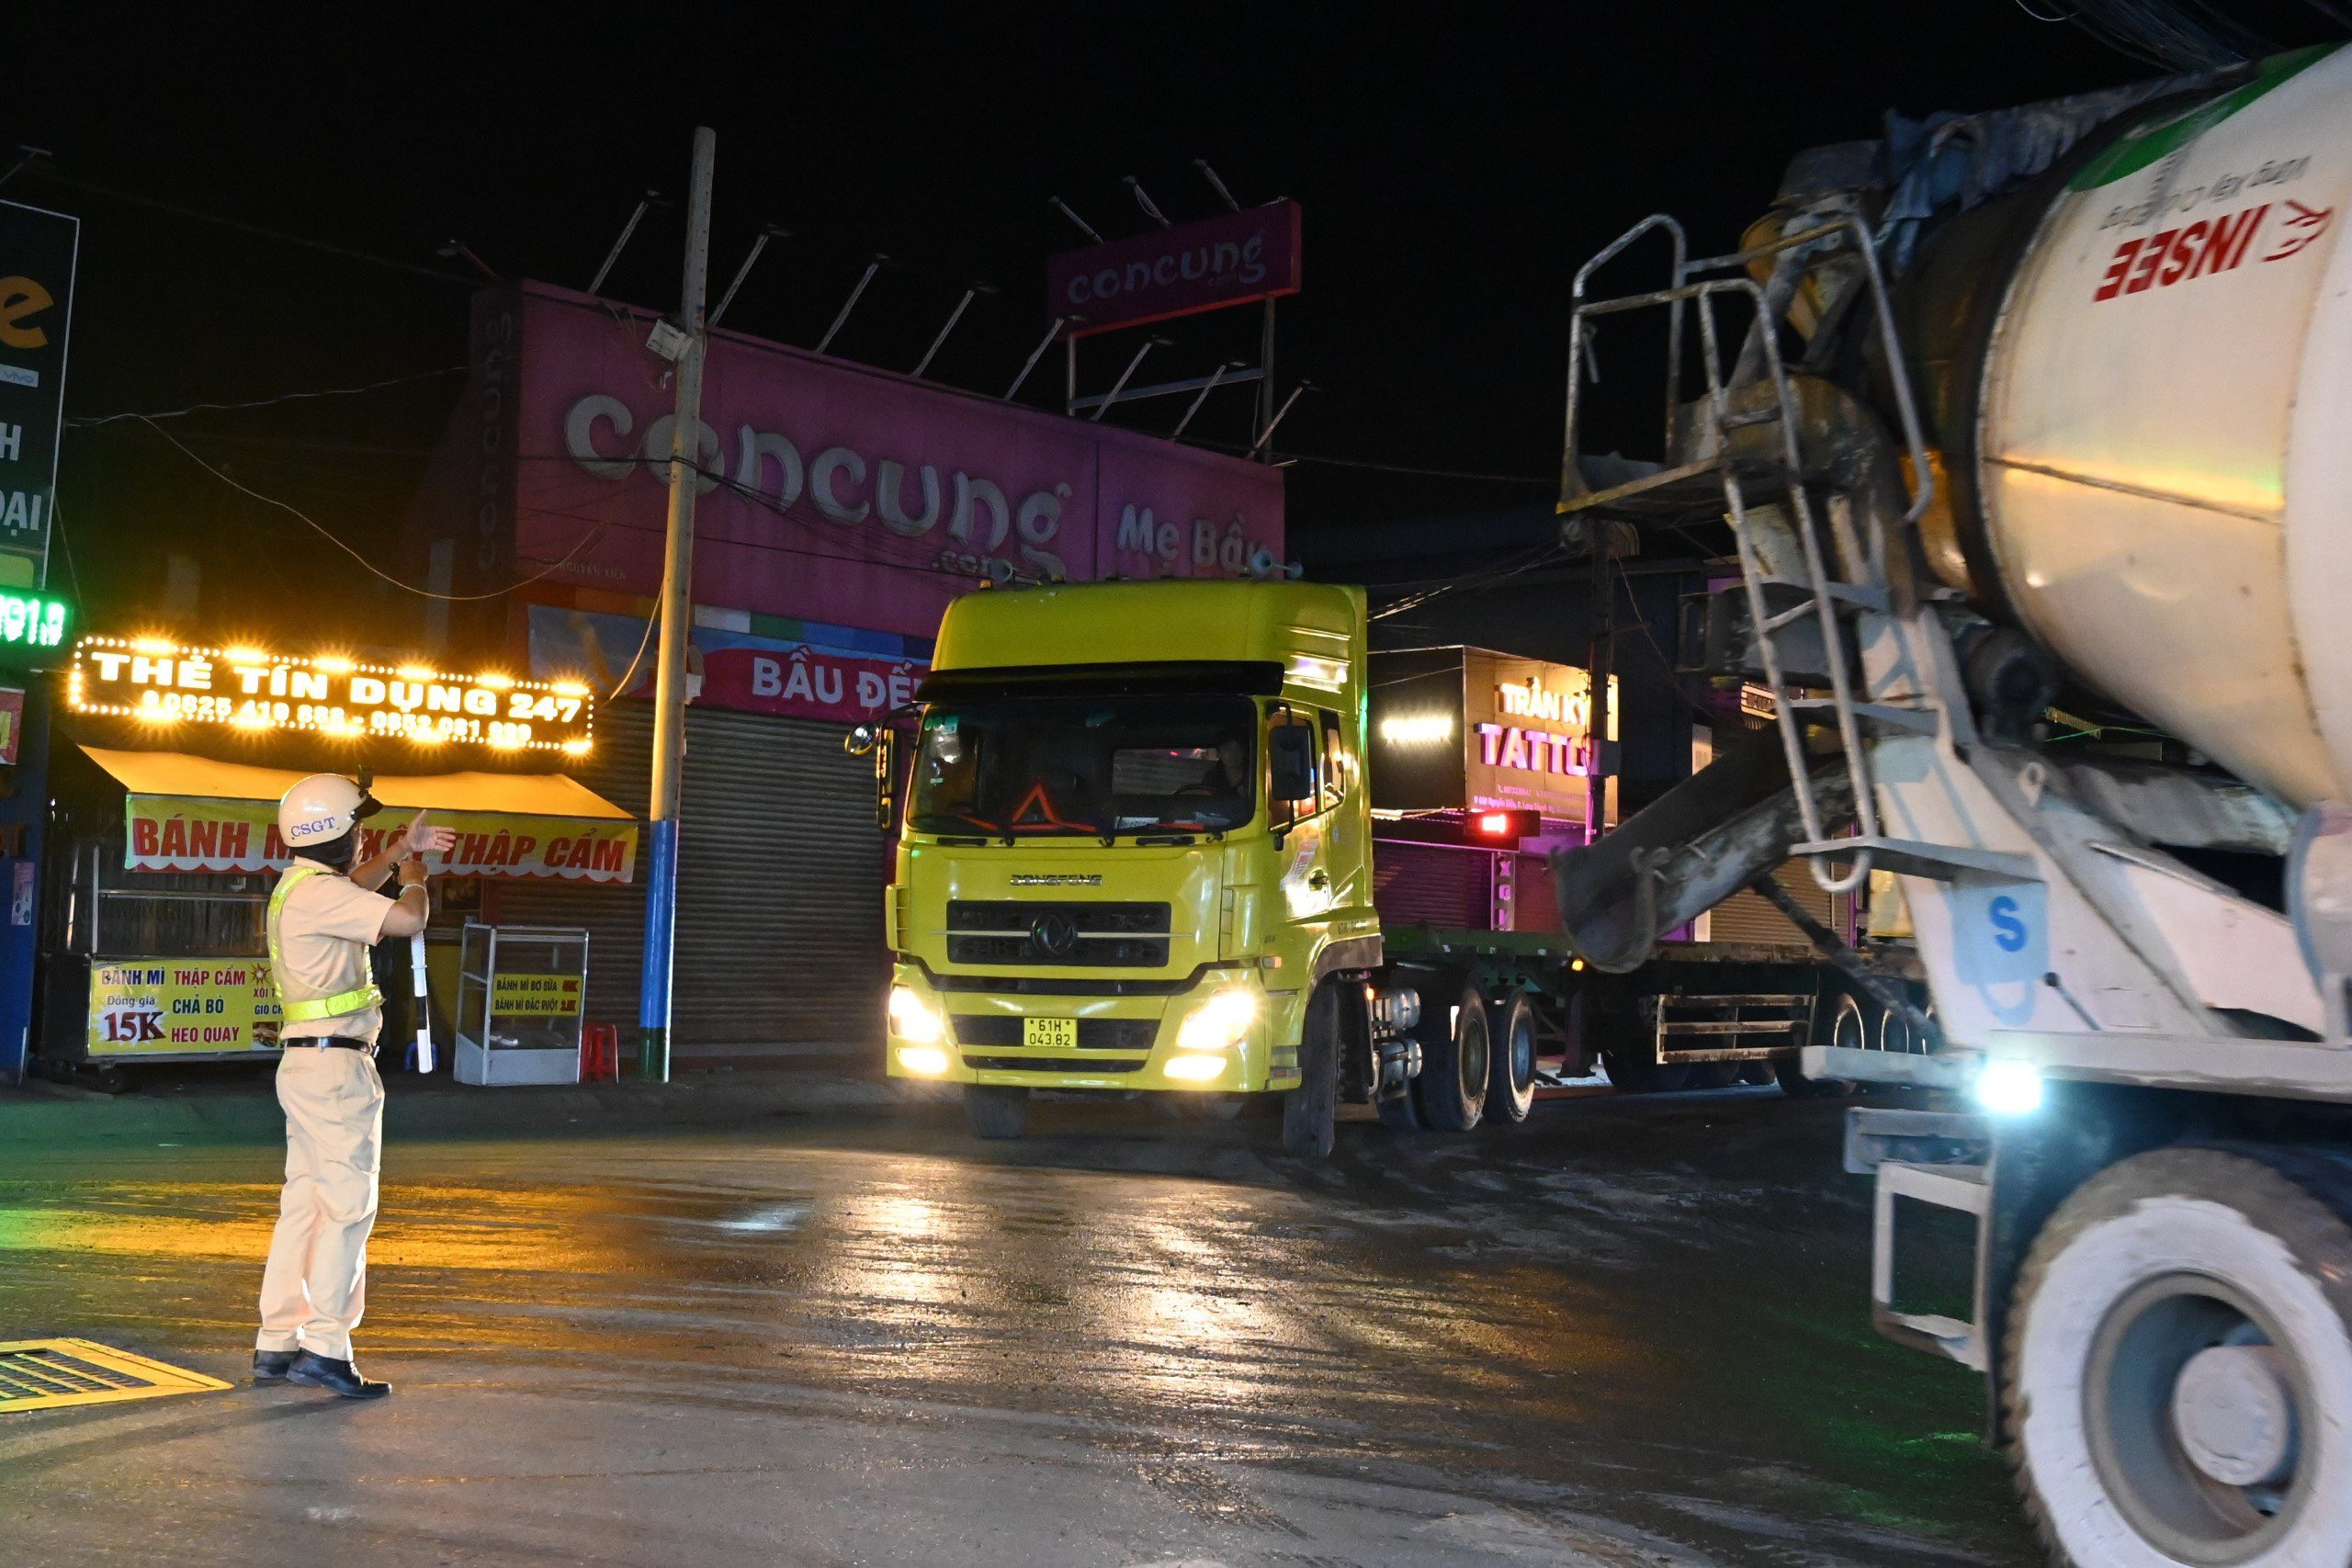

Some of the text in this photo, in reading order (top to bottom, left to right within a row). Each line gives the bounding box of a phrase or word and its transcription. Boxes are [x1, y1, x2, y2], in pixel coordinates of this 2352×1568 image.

[2093, 204, 2273, 303] INSEE
[0, 491, 42, 536] ẠI
[91, 651, 582, 724] THẺ TÍN DỤNG 247
[752, 645, 922, 711] BẦU ĐẾ
[1474, 723, 1590, 777] TATTO
[290, 817, 335, 837] CSGT
[132, 813, 250, 859] BÁNH
[441, 829, 537, 872] THẬP
[543, 828, 628, 872] CẨM
[102, 966, 165, 985] BÁNH MÌ
[174, 964, 245, 988] THẬP CẨM
[497, 977, 518, 991] BÁNH
[139, 995, 155, 1008] giá
[173, 994, 224, 1014] CHẢ BÒ
[495, 997, 514, 1010] BÁNH
[105, 1011, 166, 1043] 15K
[172, 1027, 240, 1043] HEO QUAY
[1038, 1020, 1061, 1032] 61H
[1029, 1032, 1070, 1046] 043.82
